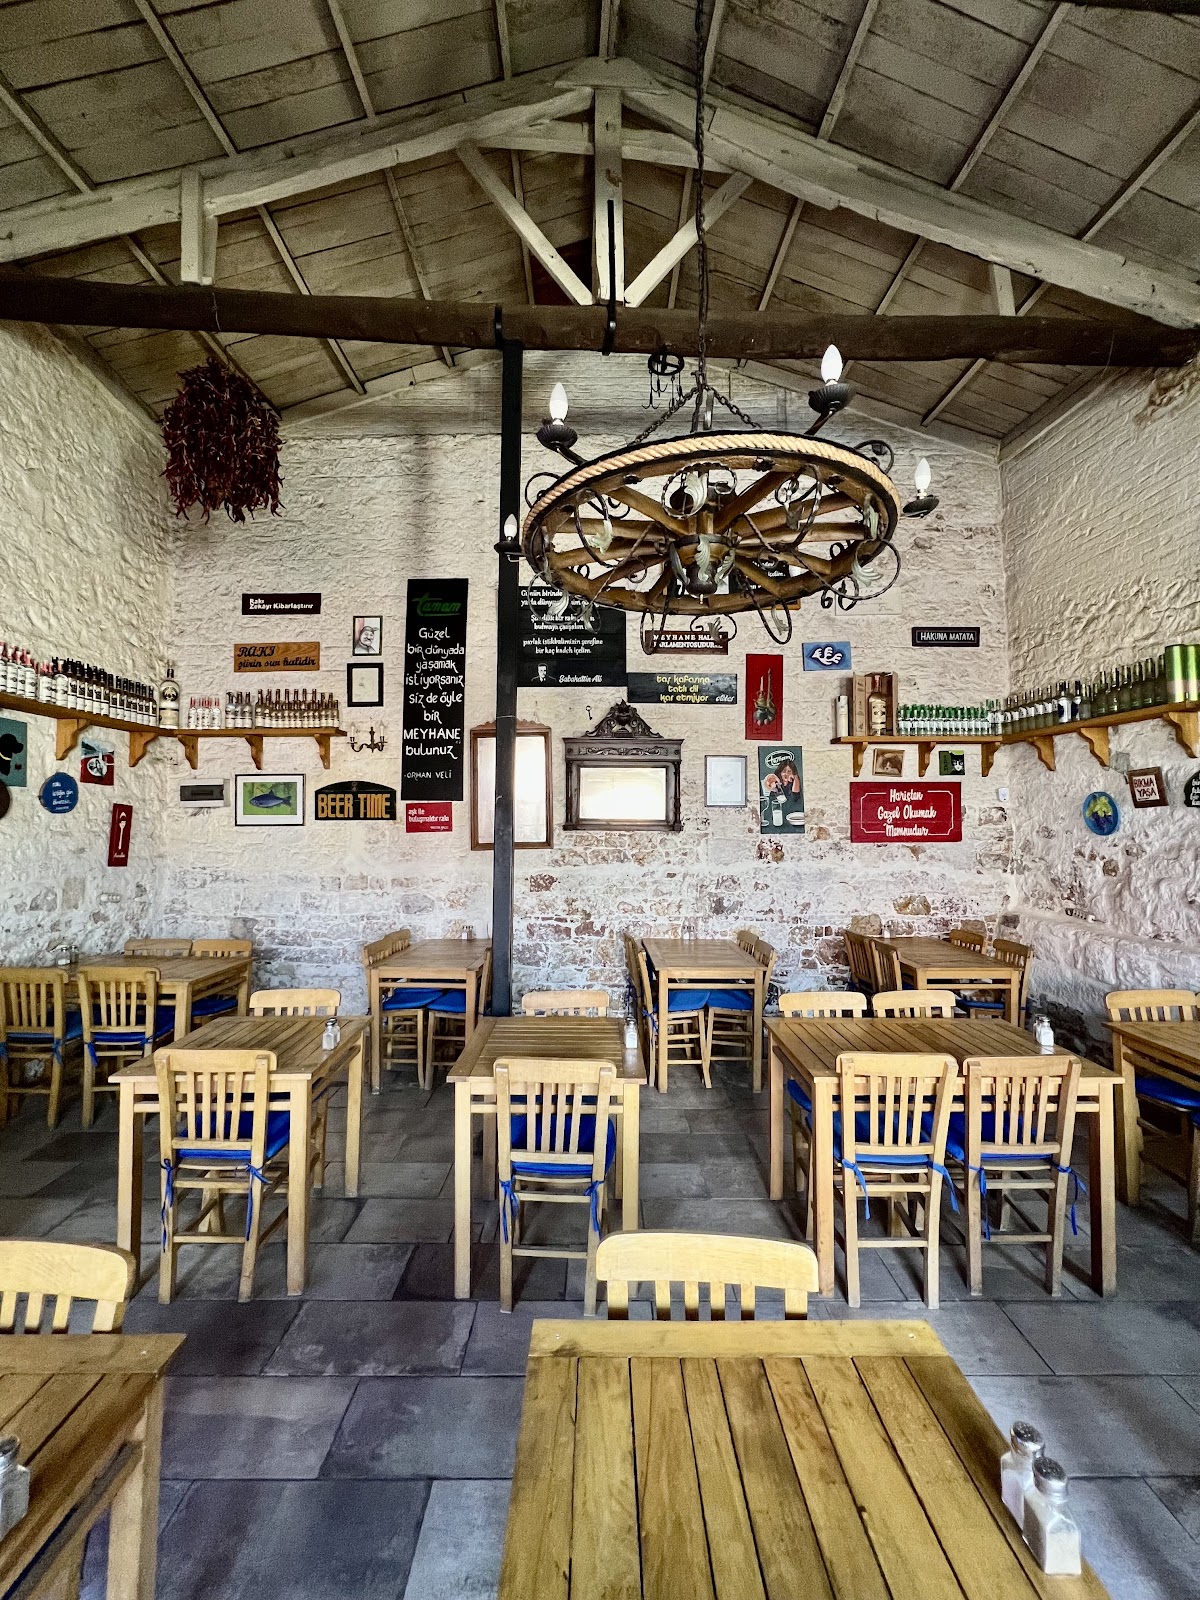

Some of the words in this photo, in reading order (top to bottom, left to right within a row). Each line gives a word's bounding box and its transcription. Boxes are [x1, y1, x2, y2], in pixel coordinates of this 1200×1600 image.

[418, 627, 450, 641] Güzel
[920, 631, 947, 641] HAKUNA
[949, 632, 975, 641] MATATA
[237, 645, 276, 658] RAKI
[425, 643, 465, 660] dünyada
[415, 659, 459, 674] yaşamak
[408, 692, 426, 709] siz
[425, 692, 438, 703] de
[440, 690, 463, 707] öyle
[403, 727, 461, 740] MEYHANE
[889, 788, 924, 802] Hariçten
[318, 793, 354, 818] BEER
[358, 793, 391, 819] TIME
[877, 805, 901, 824] Gazel
[903, 804, 937, 820] Okumak
